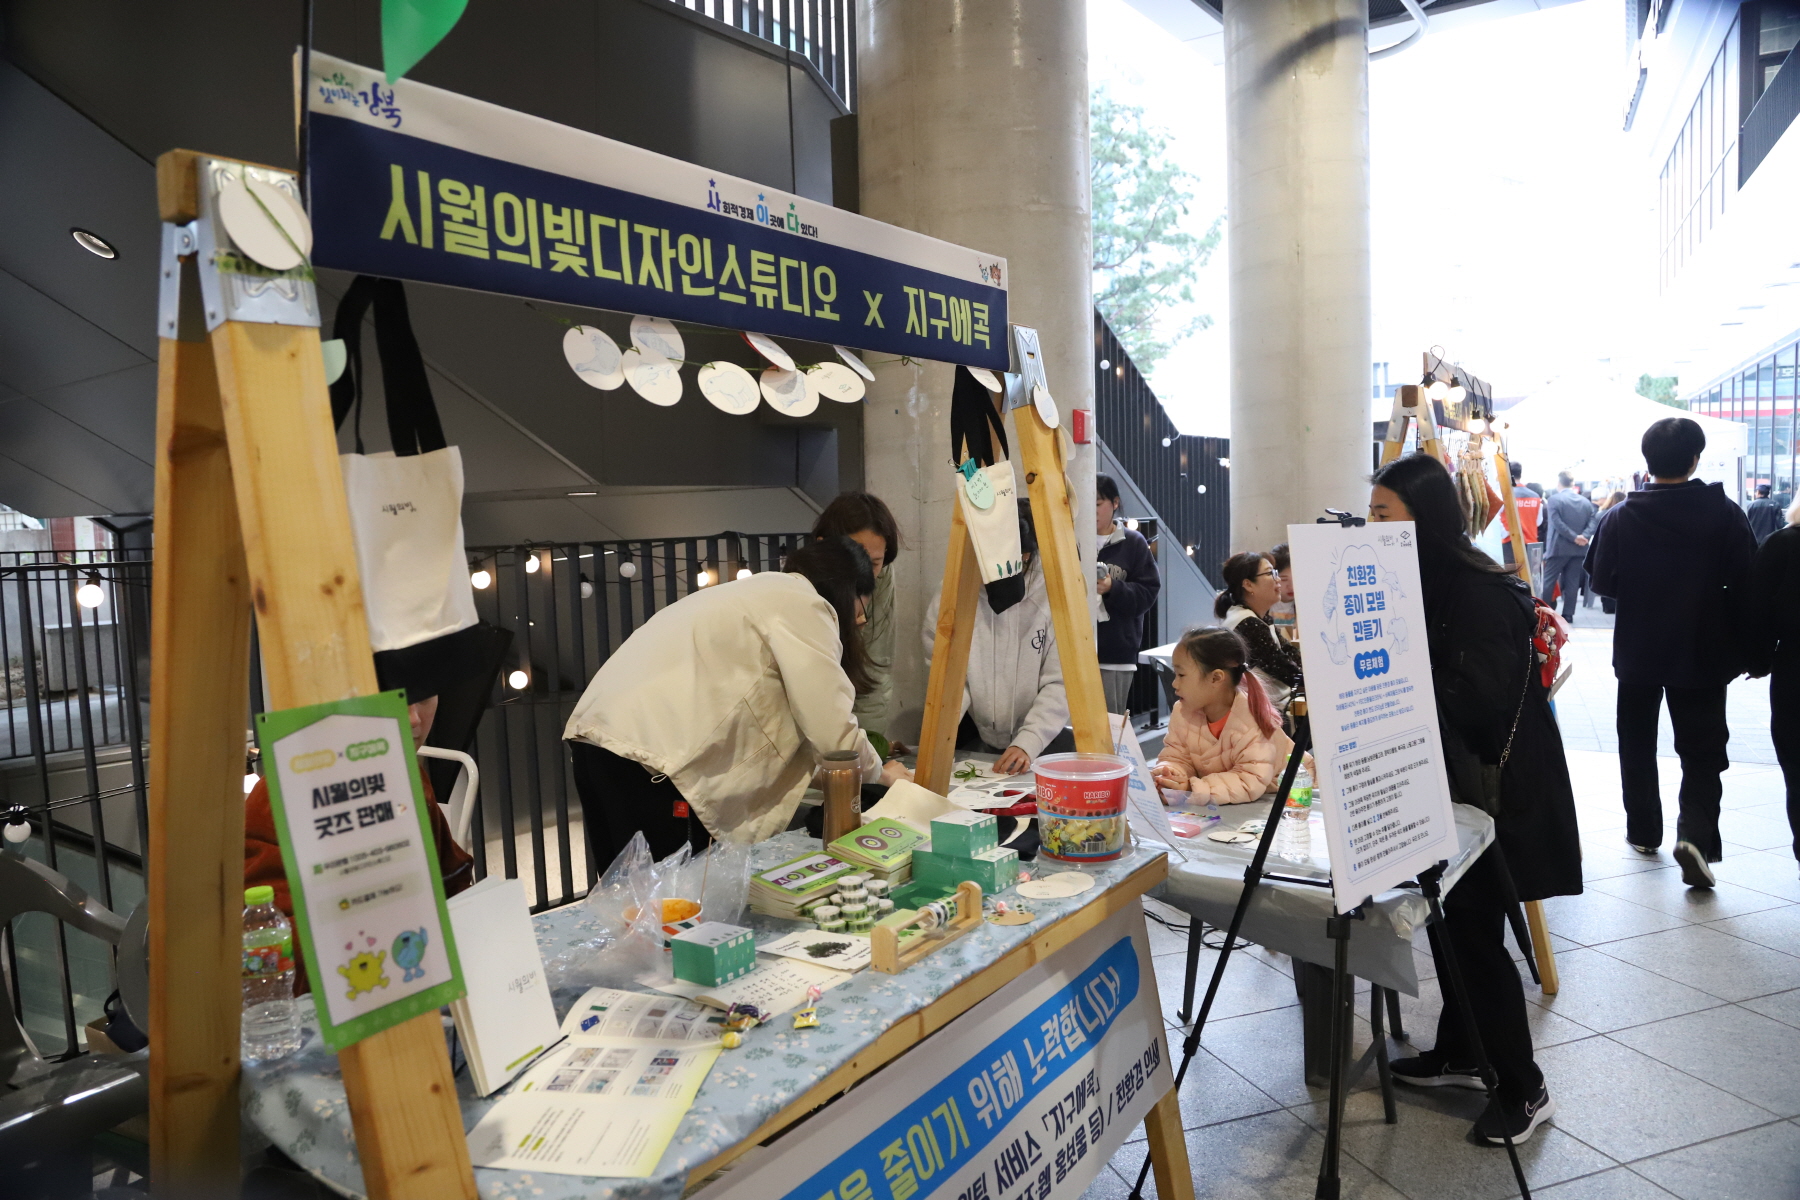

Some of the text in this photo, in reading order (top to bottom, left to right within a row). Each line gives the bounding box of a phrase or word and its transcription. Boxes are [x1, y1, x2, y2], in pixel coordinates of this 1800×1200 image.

[358, 82, 402, 128] 강북
[379, 163, 841, 322] 시월의빛디자인스튜디오
[903, 285, 990, 349] 지구에콕
[1347, 565, 1376, 587] 친환경
[1344, 590, 1386, 616] 종이 모빌
[1353, 618, 1383, 642] 만들기
[1359, 655, 1384, 672] 무료체험
[311, 773, 386, 810] 시월의빛
[1084, 790, 1110, 800] HARIBO
[313, 800, 395, 840] 굿즈 판매
[728, 932, 754, 948] WAS
[716, 961, 756, 986] TREE
[879, 1096, 970, 1200] 줄이기
[968, 1050, 1024, 1130] 위해
[1055, 1125, 1088, 1185] 홍보물
[1115, 1058, 1144, 1114] 친환경
[994, 1130, 1044, 1194] 서비스
